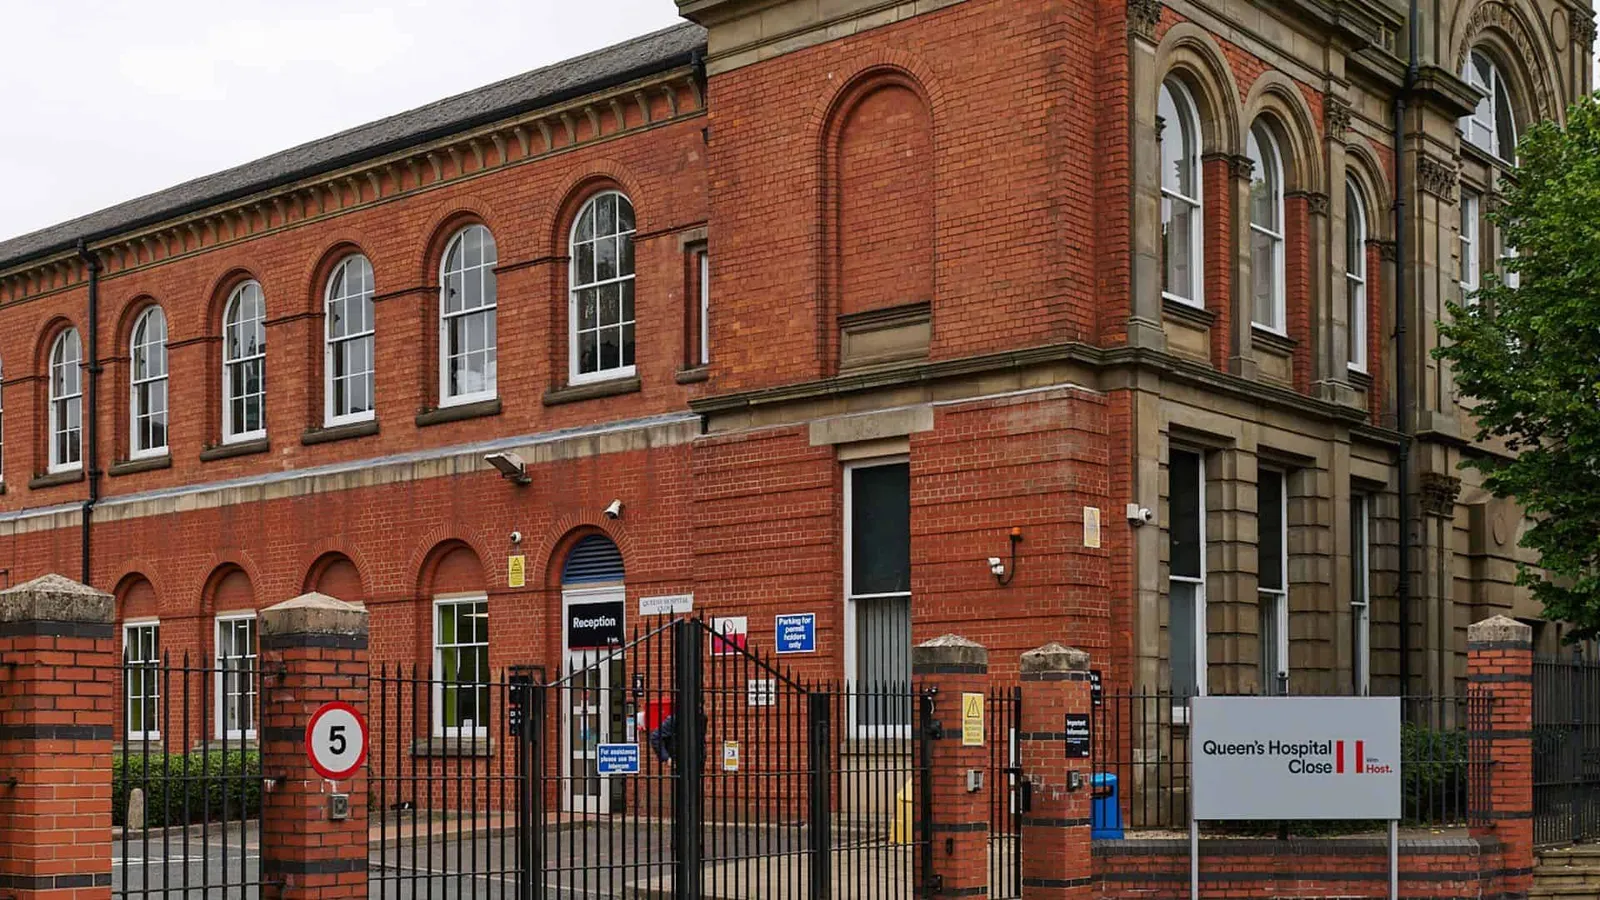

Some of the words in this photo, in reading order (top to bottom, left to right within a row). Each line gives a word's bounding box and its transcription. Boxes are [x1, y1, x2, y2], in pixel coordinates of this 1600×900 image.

[573, 616, 616, 629] Reception
[779, 617, 801, 626] Parking
[802, 616, 811, 624] for
[785, 625, 805, 633] permit
[784, 633, 806, 641] holders
[329, 726, 346, 754] 5
[1203, 740, 1264, 756] Queen's
[1269, 740, 1332, 758] Hospital
[1288, 760, 1332, 774] Close
[1366, 764, 1393, 774] Host.
